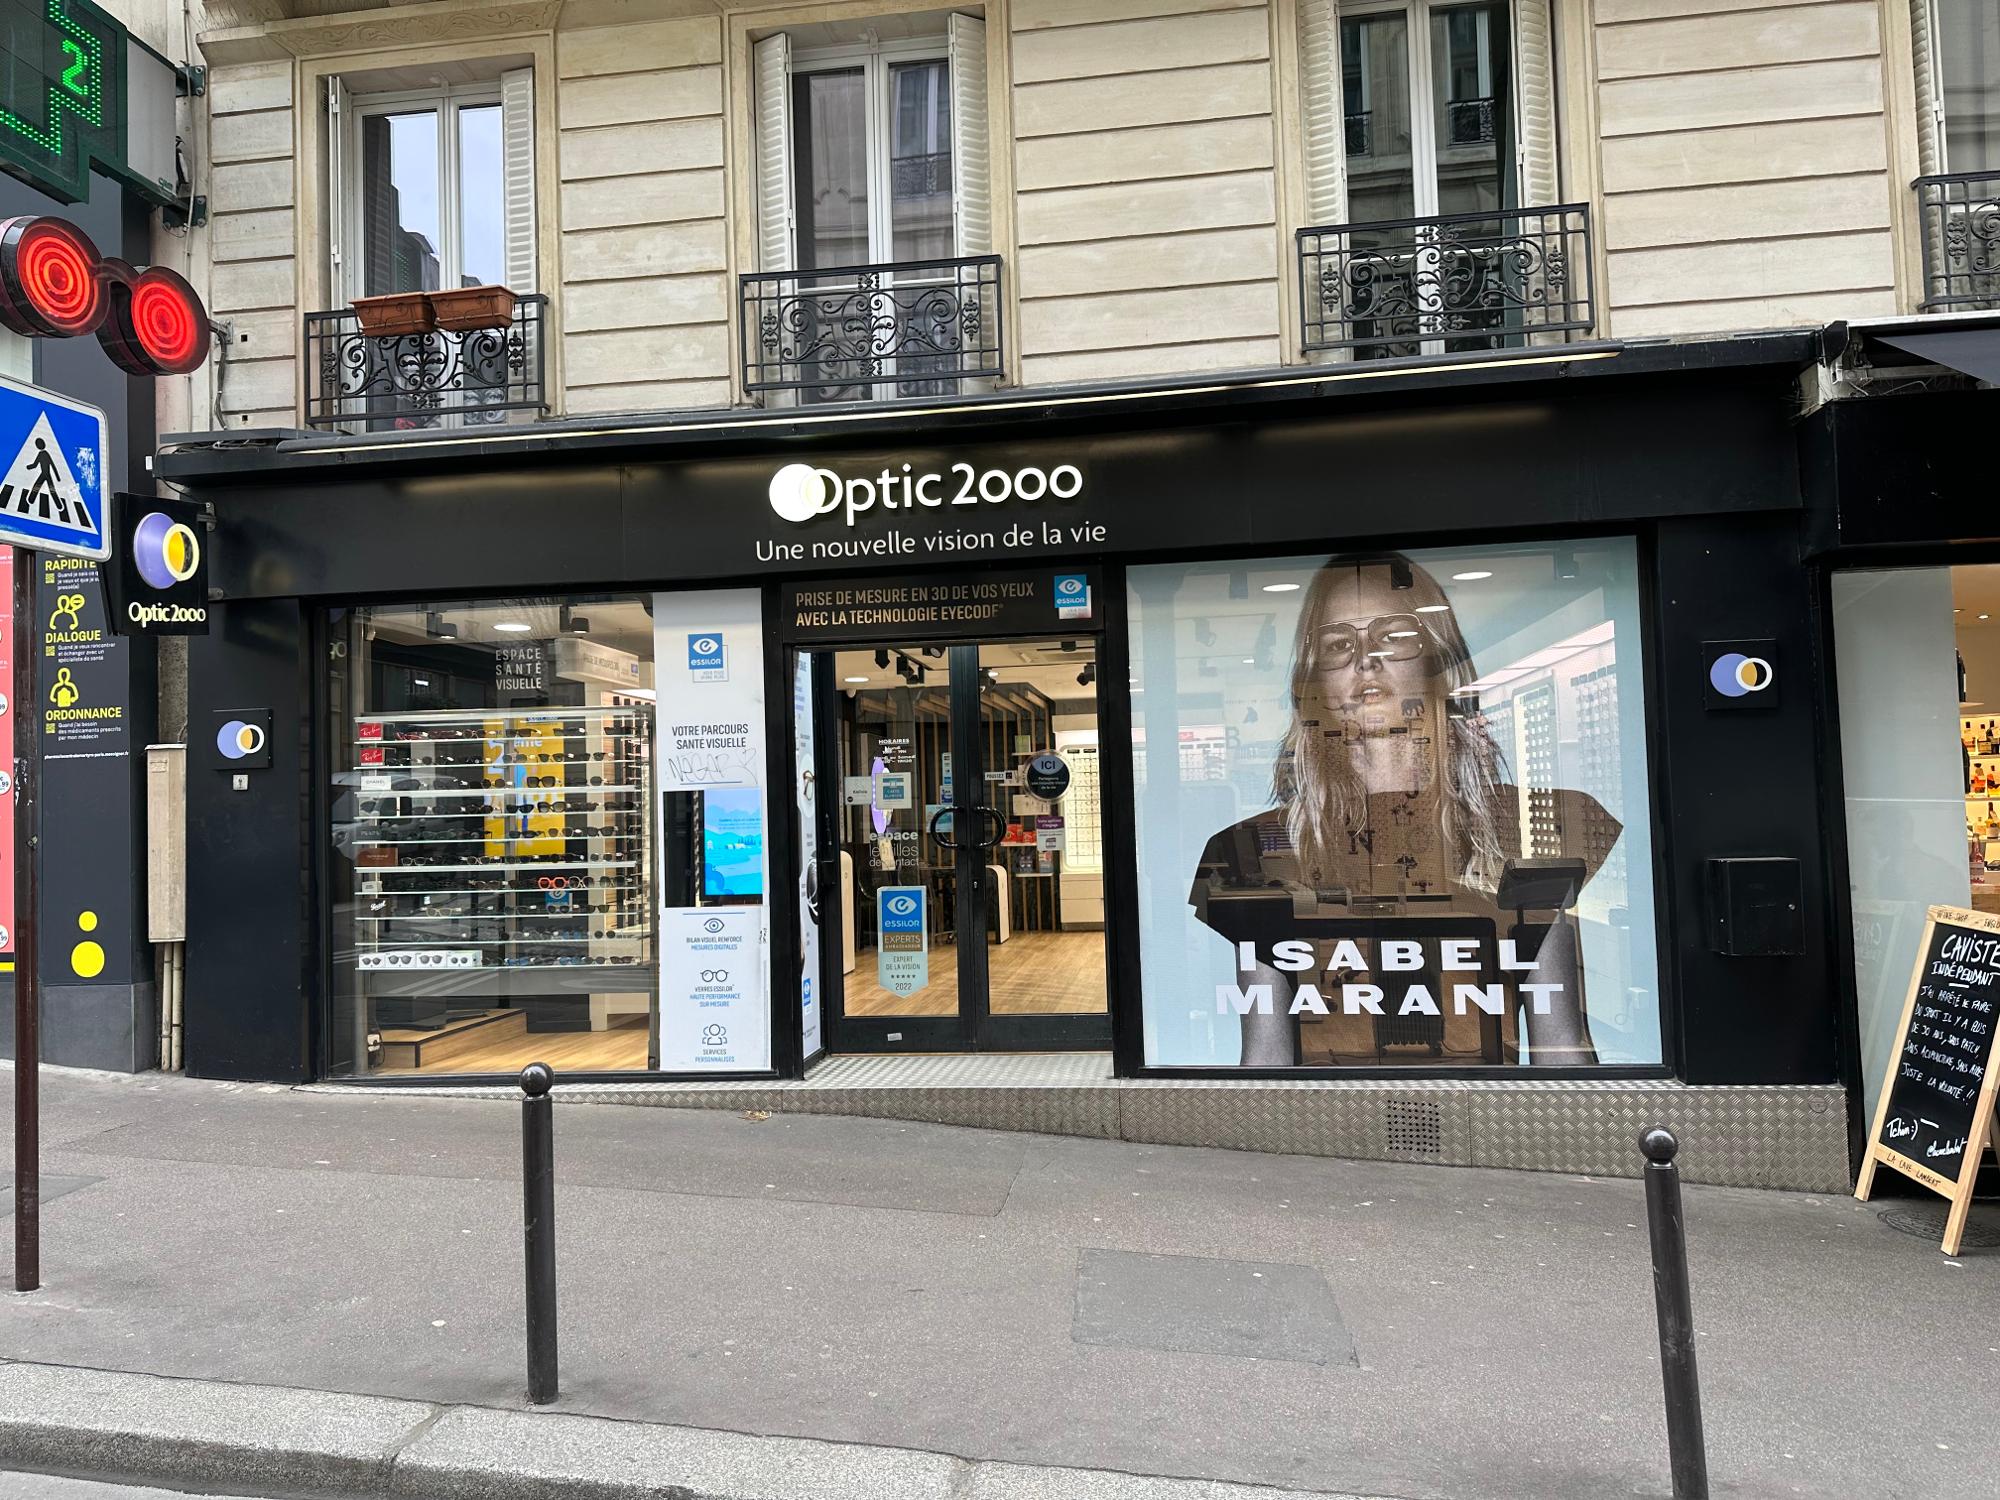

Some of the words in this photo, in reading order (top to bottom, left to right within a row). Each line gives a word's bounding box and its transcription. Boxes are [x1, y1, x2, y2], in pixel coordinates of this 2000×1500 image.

[62, 39, 88, 96] 2
[801, 463, 942, 526] Optic
[951, 463, 1083, 505] 2000
[755, 540, 804, 561] Une
[812, 530, 916, 558] nouvelle
[924, 529, 994, 553] vision
[1003, 523, 1034, 547] de
[1042, 522, 1062, 545] la
[1070, 520, 1107, 543] vie
[796, 592, 833, 607] PRISE
[836, 591, 852, 605] DE
[856, 588, 908, 604] MESURE
[911, 587, 928, 602] EN
[931, 586, 949, 601] 3D
[952, 585, 969, 600] DE
[972, 584, 998, 599] VOS
[1000, 582, 1034, 598] YEUX
[128, 601, 171, 628] Optic
[171, 604, 206, 622] 2000
[796, 611, 828, 627] AVEC
[831, 611, 847, 625] LA
[849, 606, 938, 625] TECHNOLOGIE
[45, 630, 101, 643] DIALOGUE
[495, 648, 541, 660] ESPACE
[495, 660, 541, 676] SANTÉ
[496, 678, 542, 690] VISUELLE
[46, 707, 122, 720] ORDONNANCE
[672, 725, 700, 736] VOTRE
[701, 723, 749, 735] PARCOURS
[706, 737, 746, 748] VISUELLE
[1041, 760, 1056, 769] ICI
[869, 832, 918, 841] epace
[884, 934, 921, 944] EXPERTS
[1238, 939, 1541, 972] ISABEL
[1941, 934, 2000, 968] CAVISTE
[895, 982, 912, 991] 2022
[1216, 983, 1564, 1016] MARANT
[1953, 1016, 1962, 1026] Y
[1961, 1018, 1969, 1030] A
